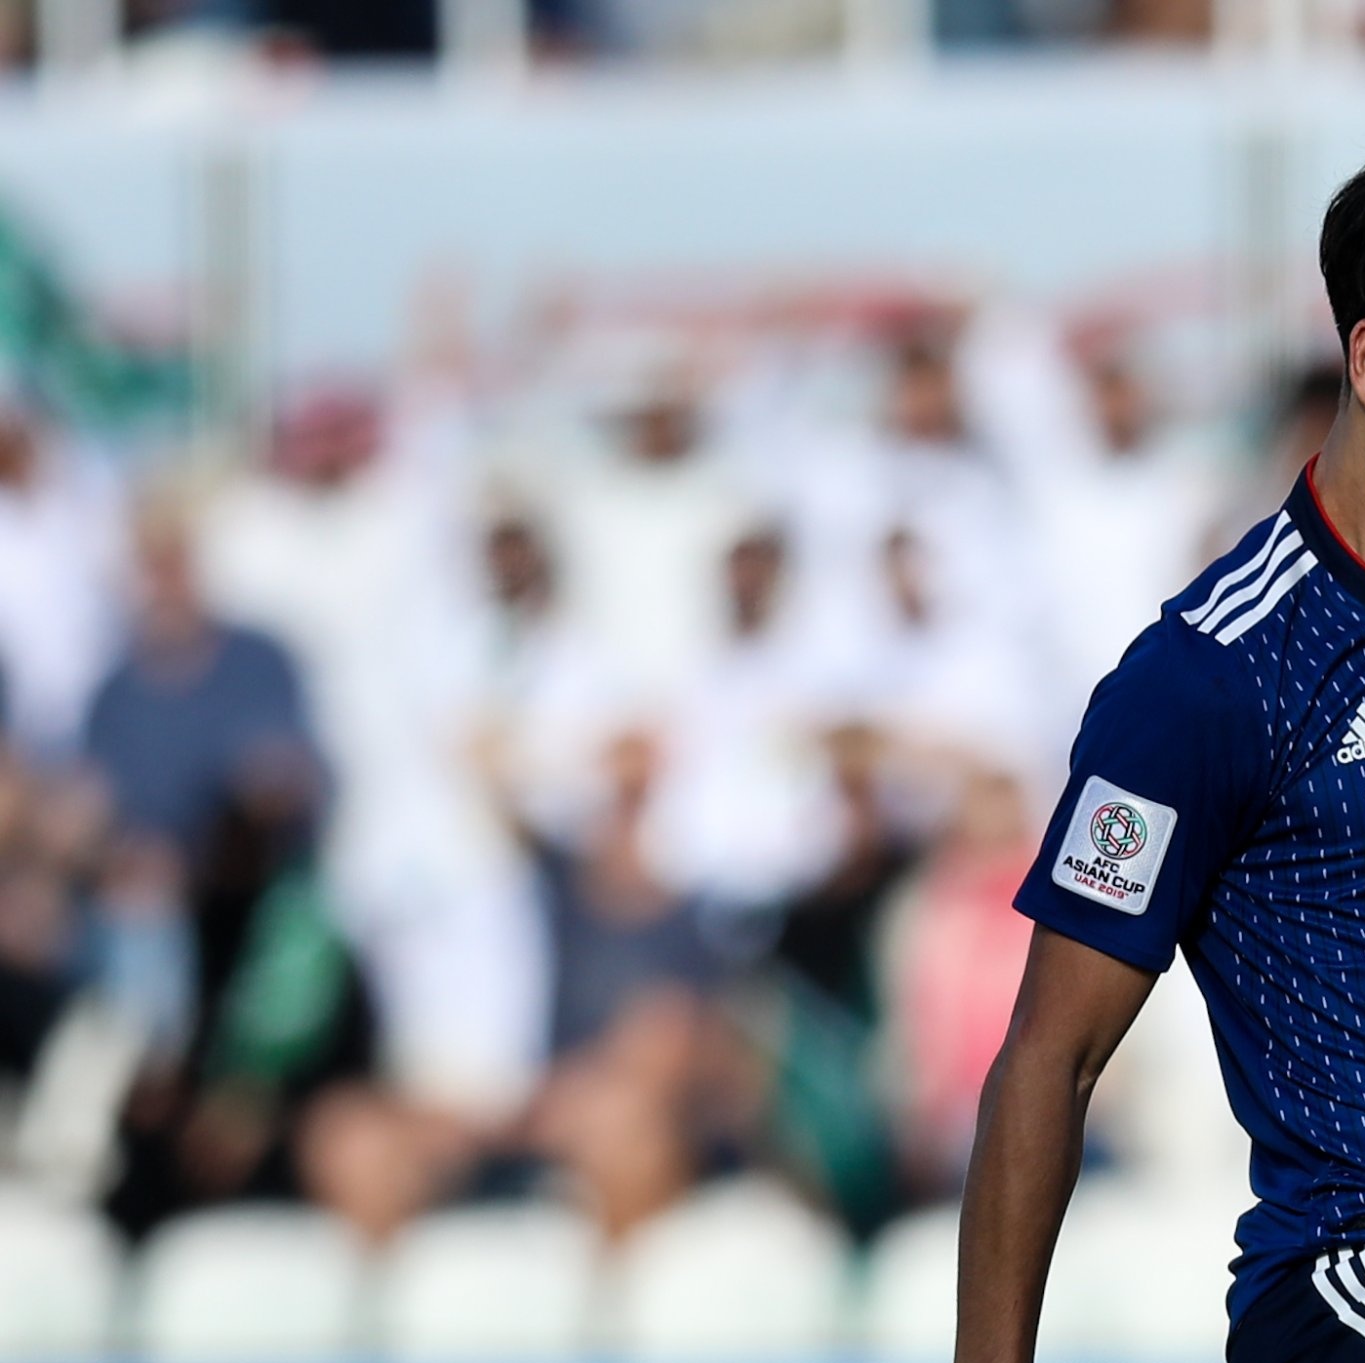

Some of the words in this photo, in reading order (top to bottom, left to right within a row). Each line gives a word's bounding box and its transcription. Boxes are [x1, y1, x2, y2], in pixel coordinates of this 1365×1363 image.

[1092, 856, 1120, 874] AFC
[1062, 855, 1110, 883] ASIAN
[1111, 875, 1146, 894] CUP
[1073, 872, 1096, 889] UAE
